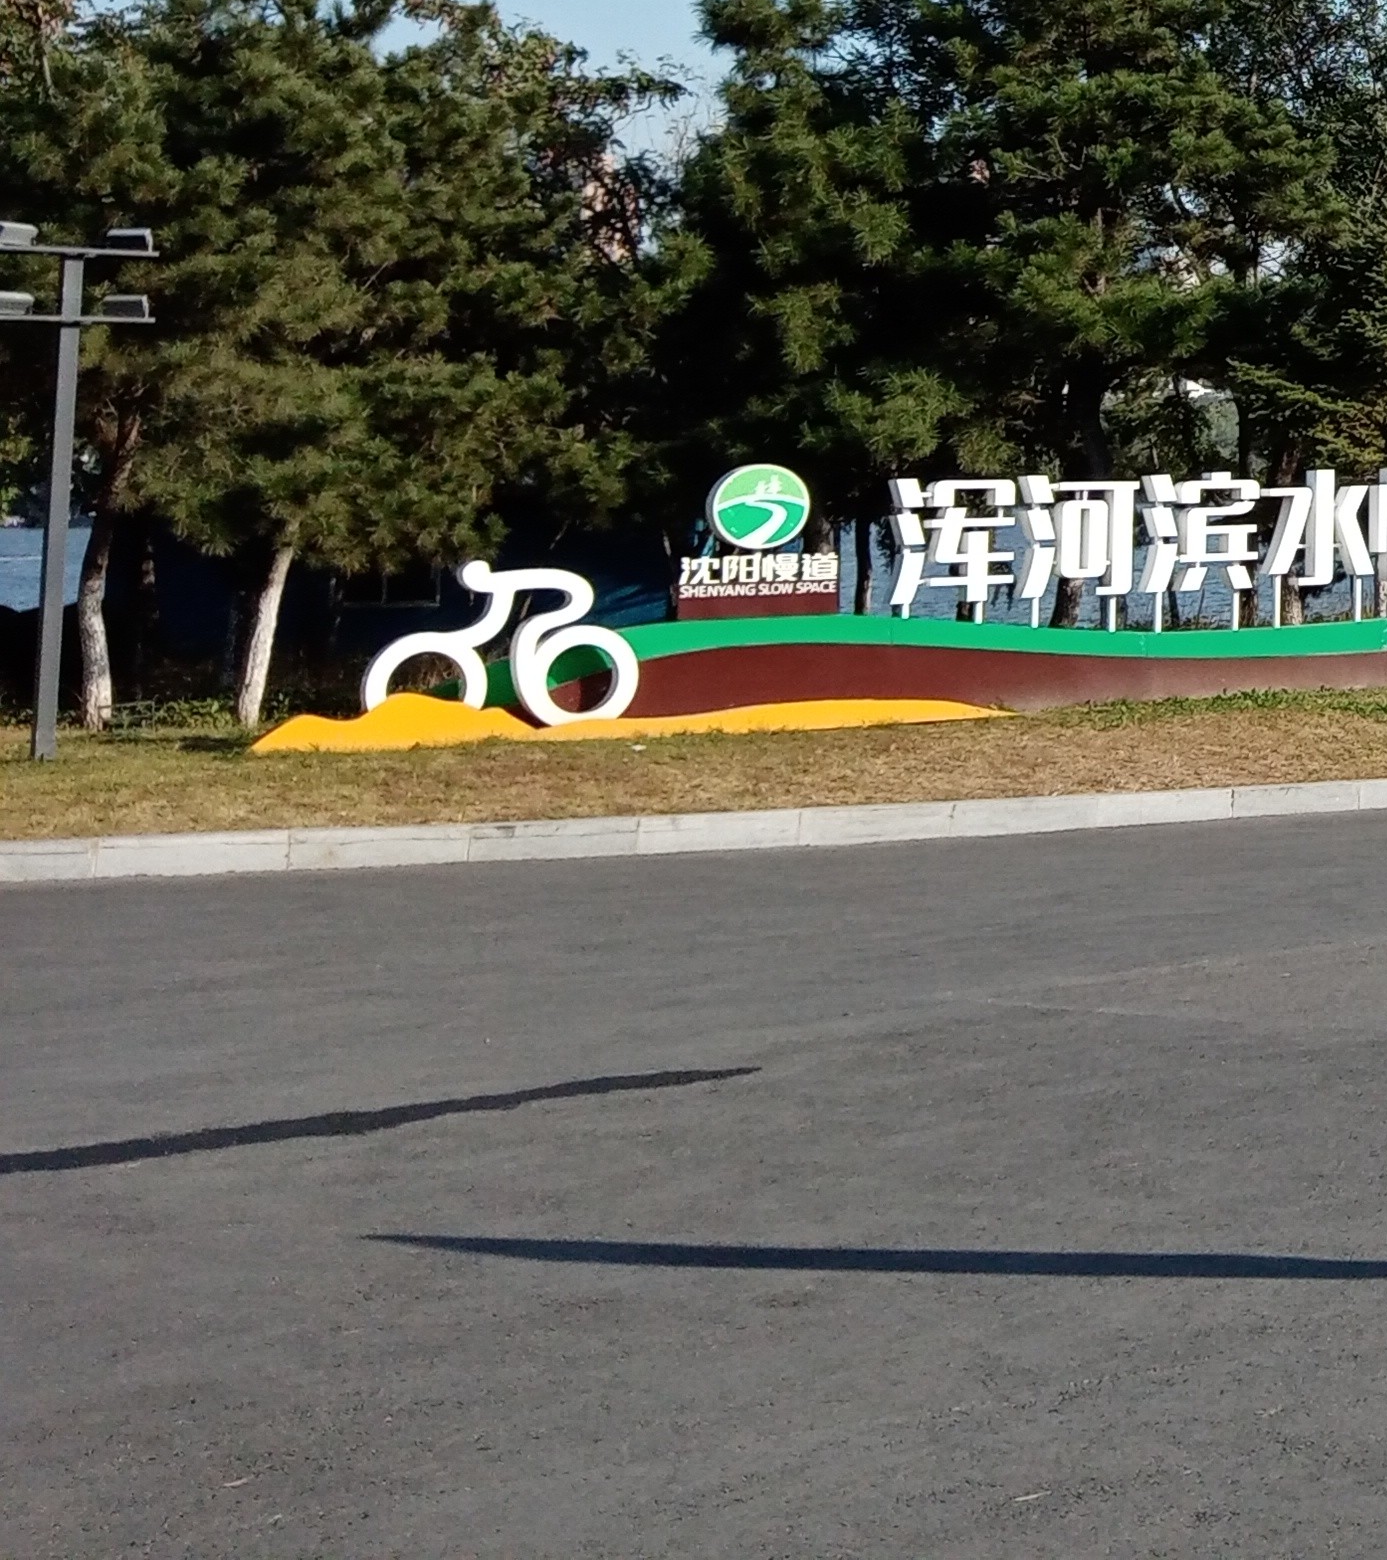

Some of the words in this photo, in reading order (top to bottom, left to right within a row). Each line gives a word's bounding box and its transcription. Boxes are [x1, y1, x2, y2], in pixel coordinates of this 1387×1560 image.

[679, 552, 838, 585] 沈阳慢道
[679, 584, 757, 599] SHENYANG
[758, 582, 794, 595] SLOW
[795, 580, 838, 594] SPACE
